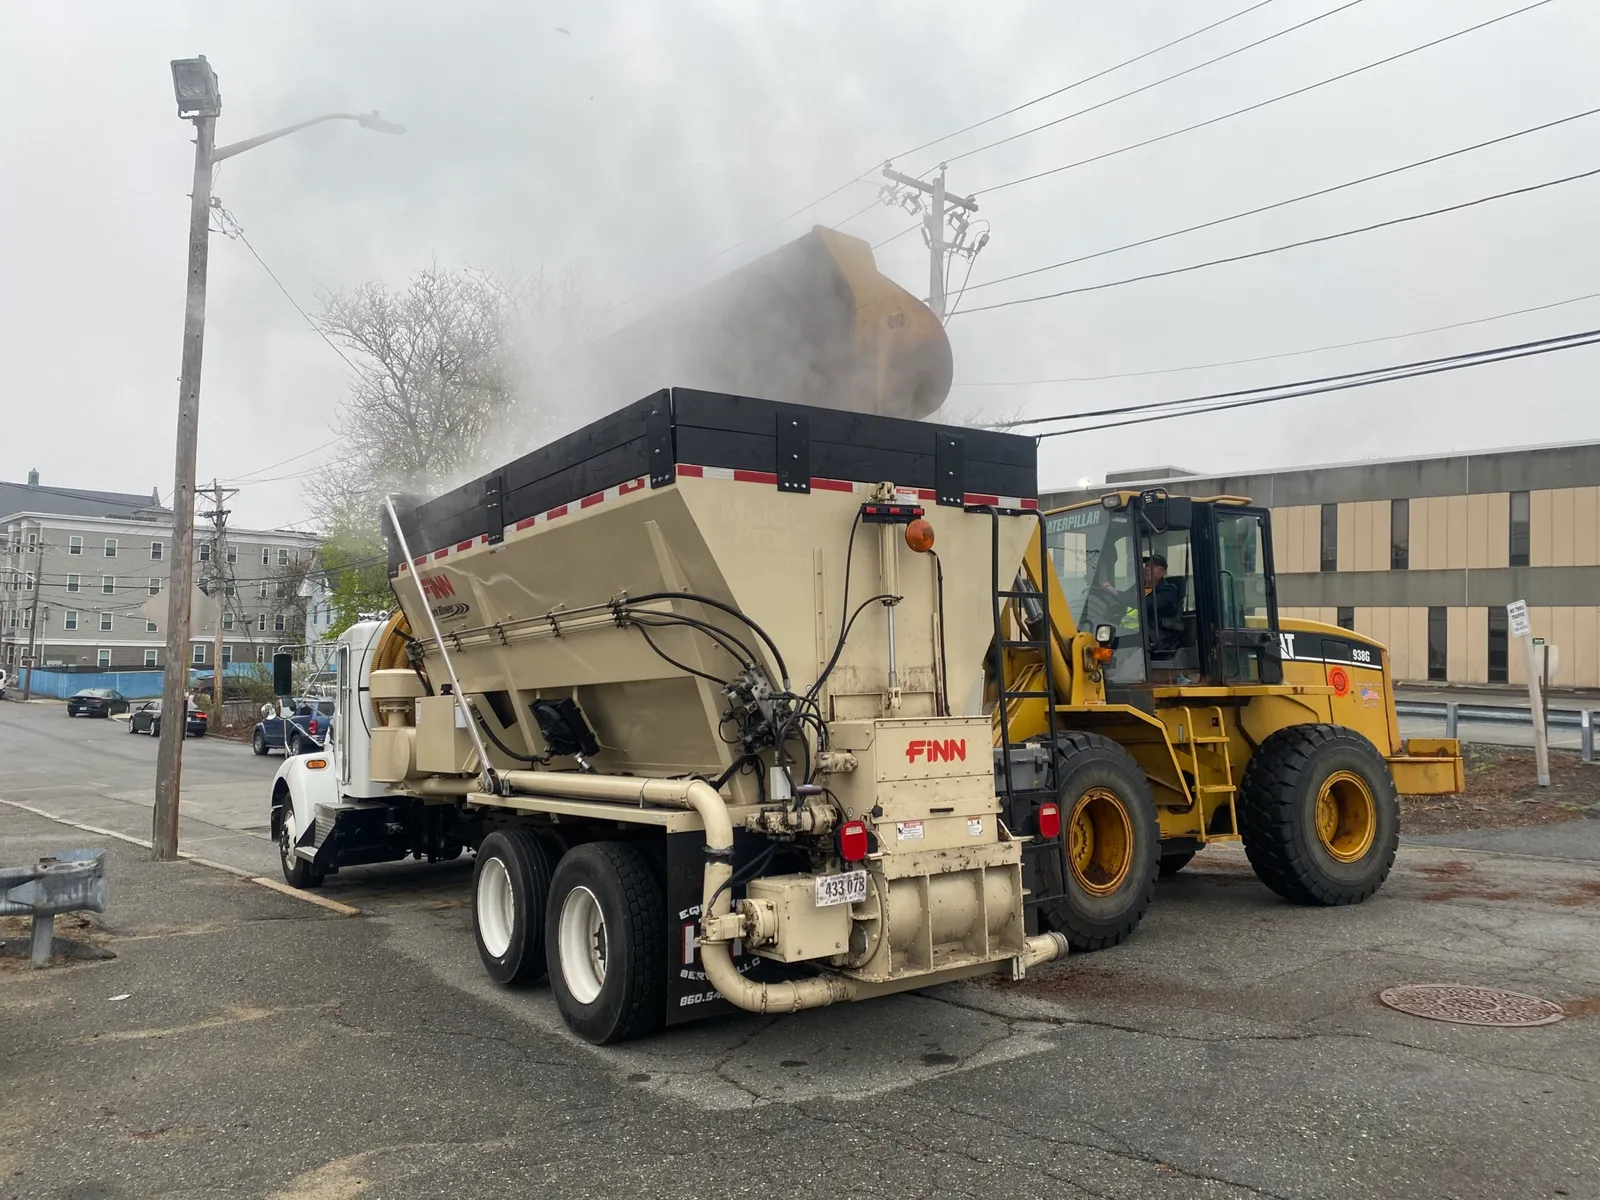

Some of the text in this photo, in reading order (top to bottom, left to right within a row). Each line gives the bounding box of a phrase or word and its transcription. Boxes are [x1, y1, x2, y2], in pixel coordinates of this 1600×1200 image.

[1046, 510, 1101, 533] ATERPILLAR
[1279, 633, 1295, 660] AT
[1352, 648, 1371, 662] 938G
[825, 880, 844, 898] 433
[847, 876, 865, 894] 078
